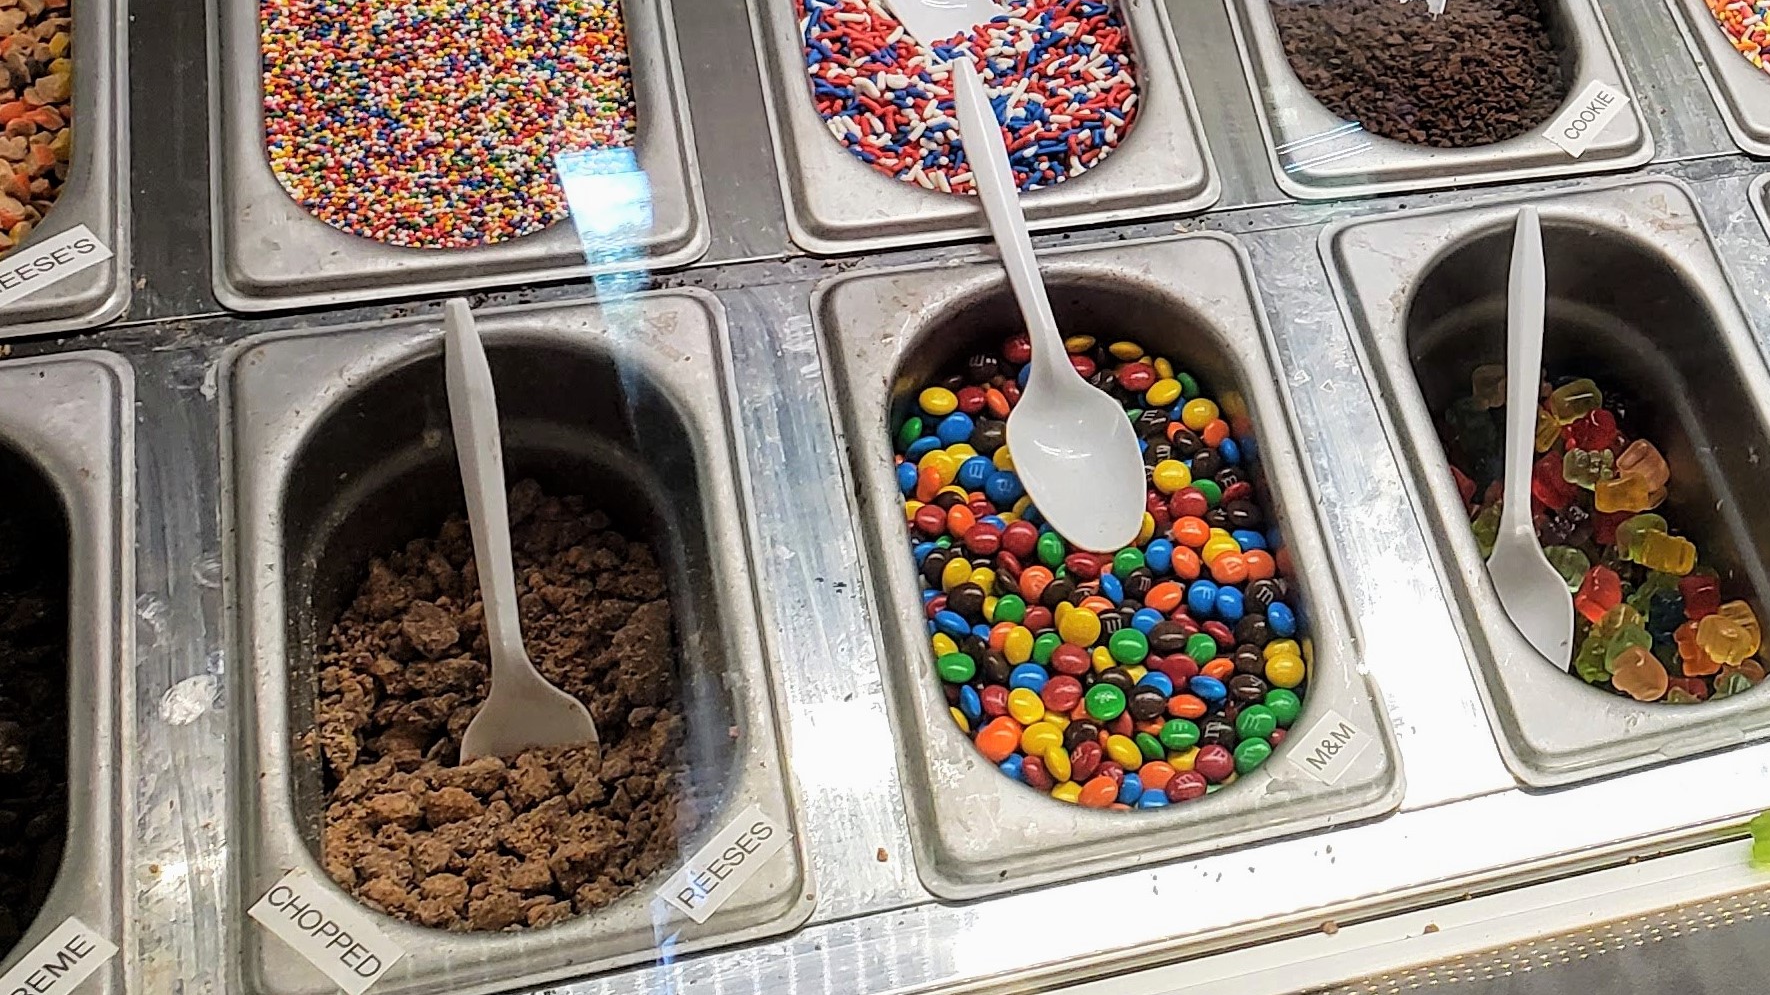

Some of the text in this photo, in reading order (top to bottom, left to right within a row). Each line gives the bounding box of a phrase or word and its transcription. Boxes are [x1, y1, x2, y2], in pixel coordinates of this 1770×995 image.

[1563, 90, 1615, 140] COOKIE
[0, 238, 96, 293] EESE'S
[1305, 721, 1356, 771] M&M
[676, 821, 773, 910] REESES
[268, 885, 382, 978] CHOPPED
